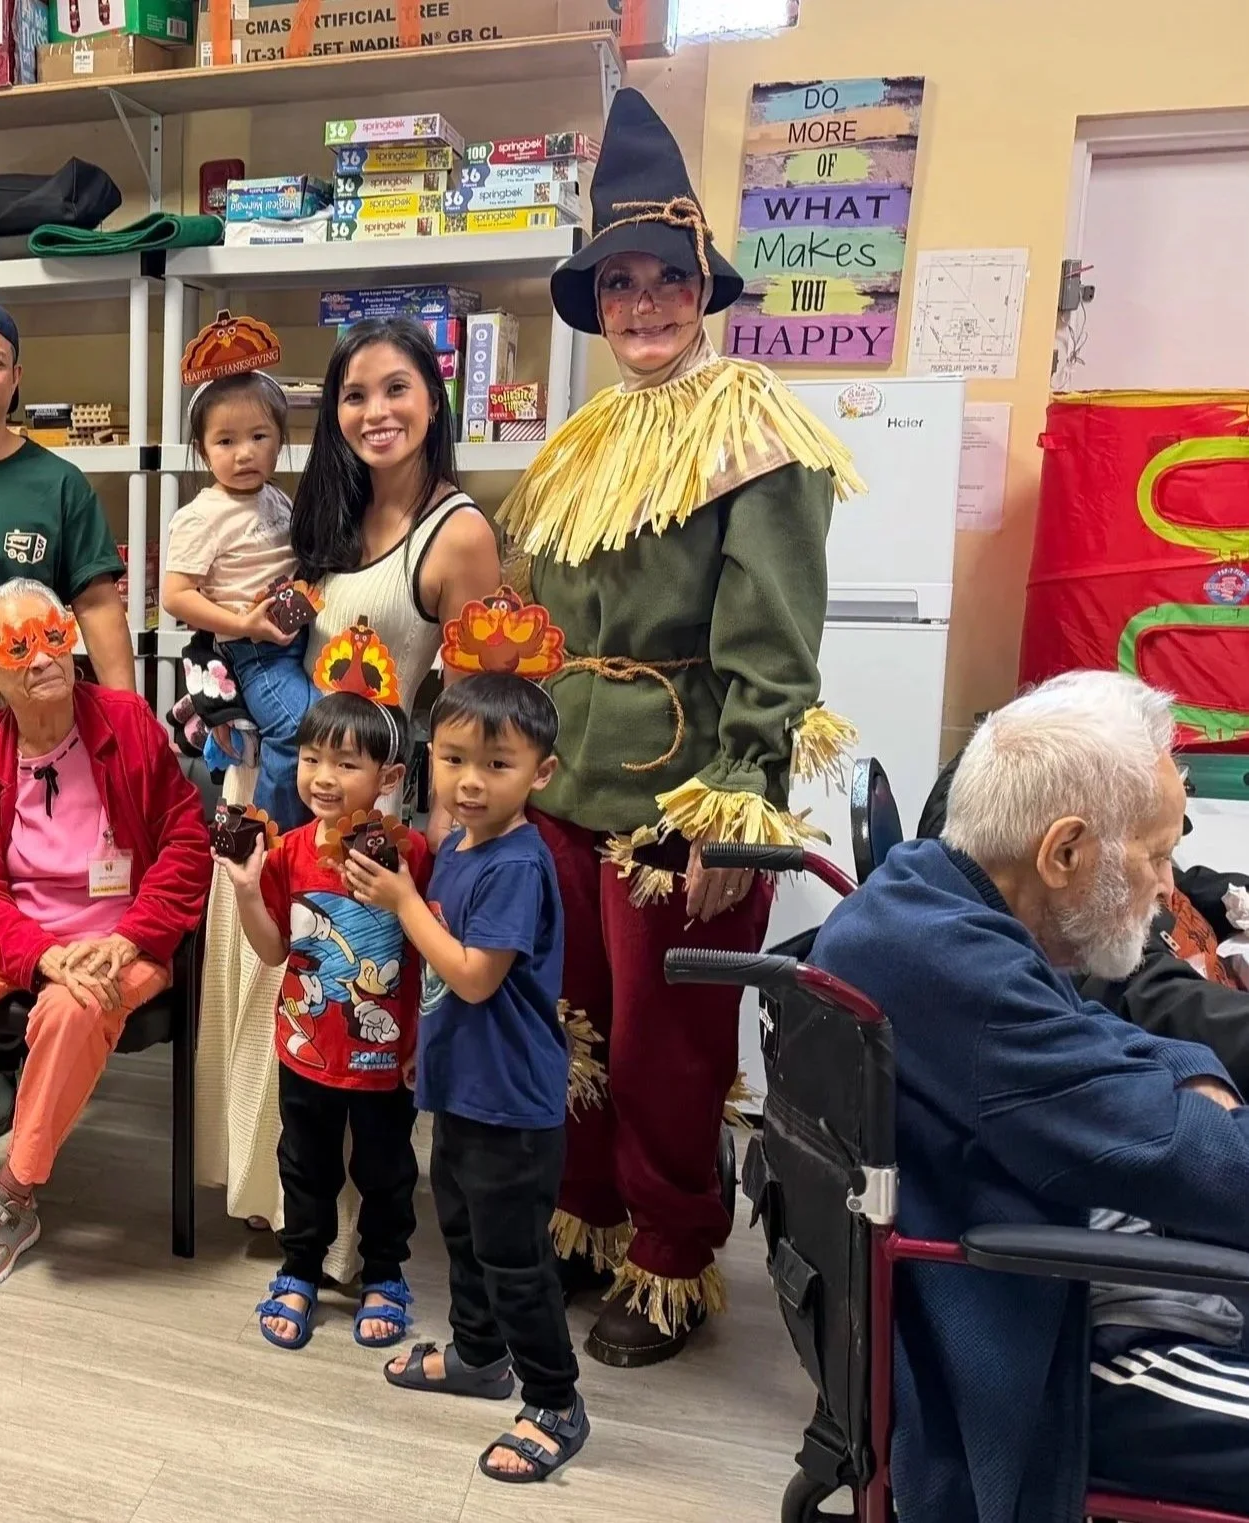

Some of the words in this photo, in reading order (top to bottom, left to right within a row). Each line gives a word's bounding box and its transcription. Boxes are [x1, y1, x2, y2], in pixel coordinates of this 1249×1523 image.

[246, 18, 291, 35] CMAS
[447, 29, 473, 43] GR
[479, 26, 503, 40] CL
[804, 88, 839, 109] DO
[329, 122, 348, 137] 36
[362, 119, 405, 133] springbok
[788, 121, 857, 143] MORE
[341, 150, 361, 166] 36
[375, 147, 418, 160] springbok
[466, 147, 487, 160] 100
[498, 138, 542, 154] springbok
[461, 168, 481, 183] 36
[496, 165, 541, 178] springbok
[817, 153, 837, 178] OF
[336, 178, 355, 193] 36
[370, 175, 413, 189] springbok
[264, 197, 298, 213] Magical
[337, 199, 355, 214] 36
[370, 198, 411, 211] springbok
[444, 190, 464, 206] 36
[479, 188, 523, 202] springbok
[230, 200, 263, 213] Mermaid
[764, 195, 891, 220] WHAT
[331, 222, 350, 236] 36
[364, 220, 407, 234] springbok
[754, 231, 877, 268] Makes
[791, 280, 827, 312] YOU
[731, 325, 890, 356] HAPPY
[183, 368, 212, 382] HAPPY
[214, 350, 279, 377] THANKSGIVING
[887, 417, 924, 428] Haier
[350, 1050, 397, 1064] SONIC
